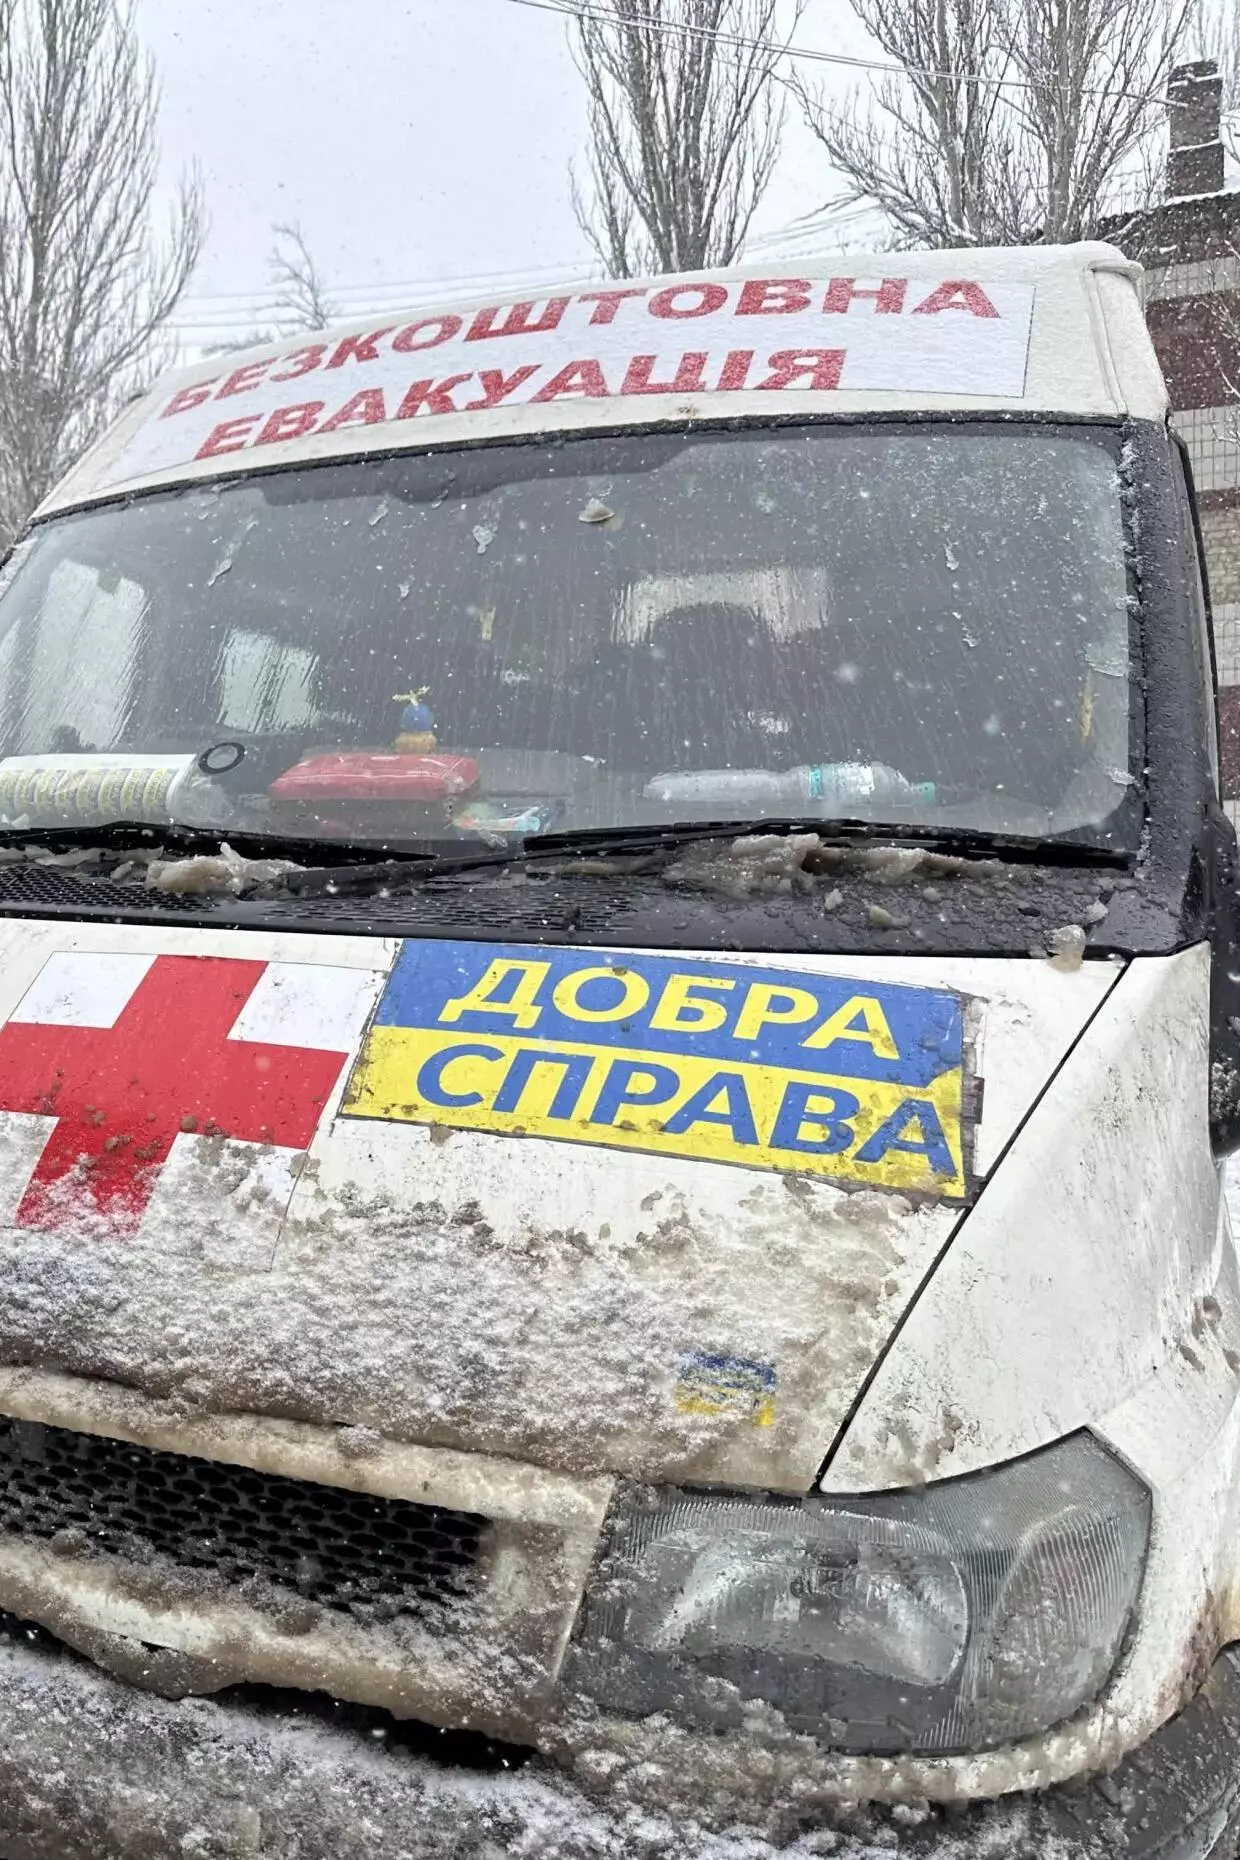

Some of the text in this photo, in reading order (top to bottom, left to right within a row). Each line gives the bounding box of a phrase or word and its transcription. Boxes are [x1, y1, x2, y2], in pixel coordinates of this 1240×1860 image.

[162, 278, 1001, 418] БЕЗКОШТОВНА
[195, 347, 847, 460] ЕВАКУАЦІЯ
[438, 957, 900, 1060] ДОБРА
[415, 1043, 960, 1178] СПРАВА
